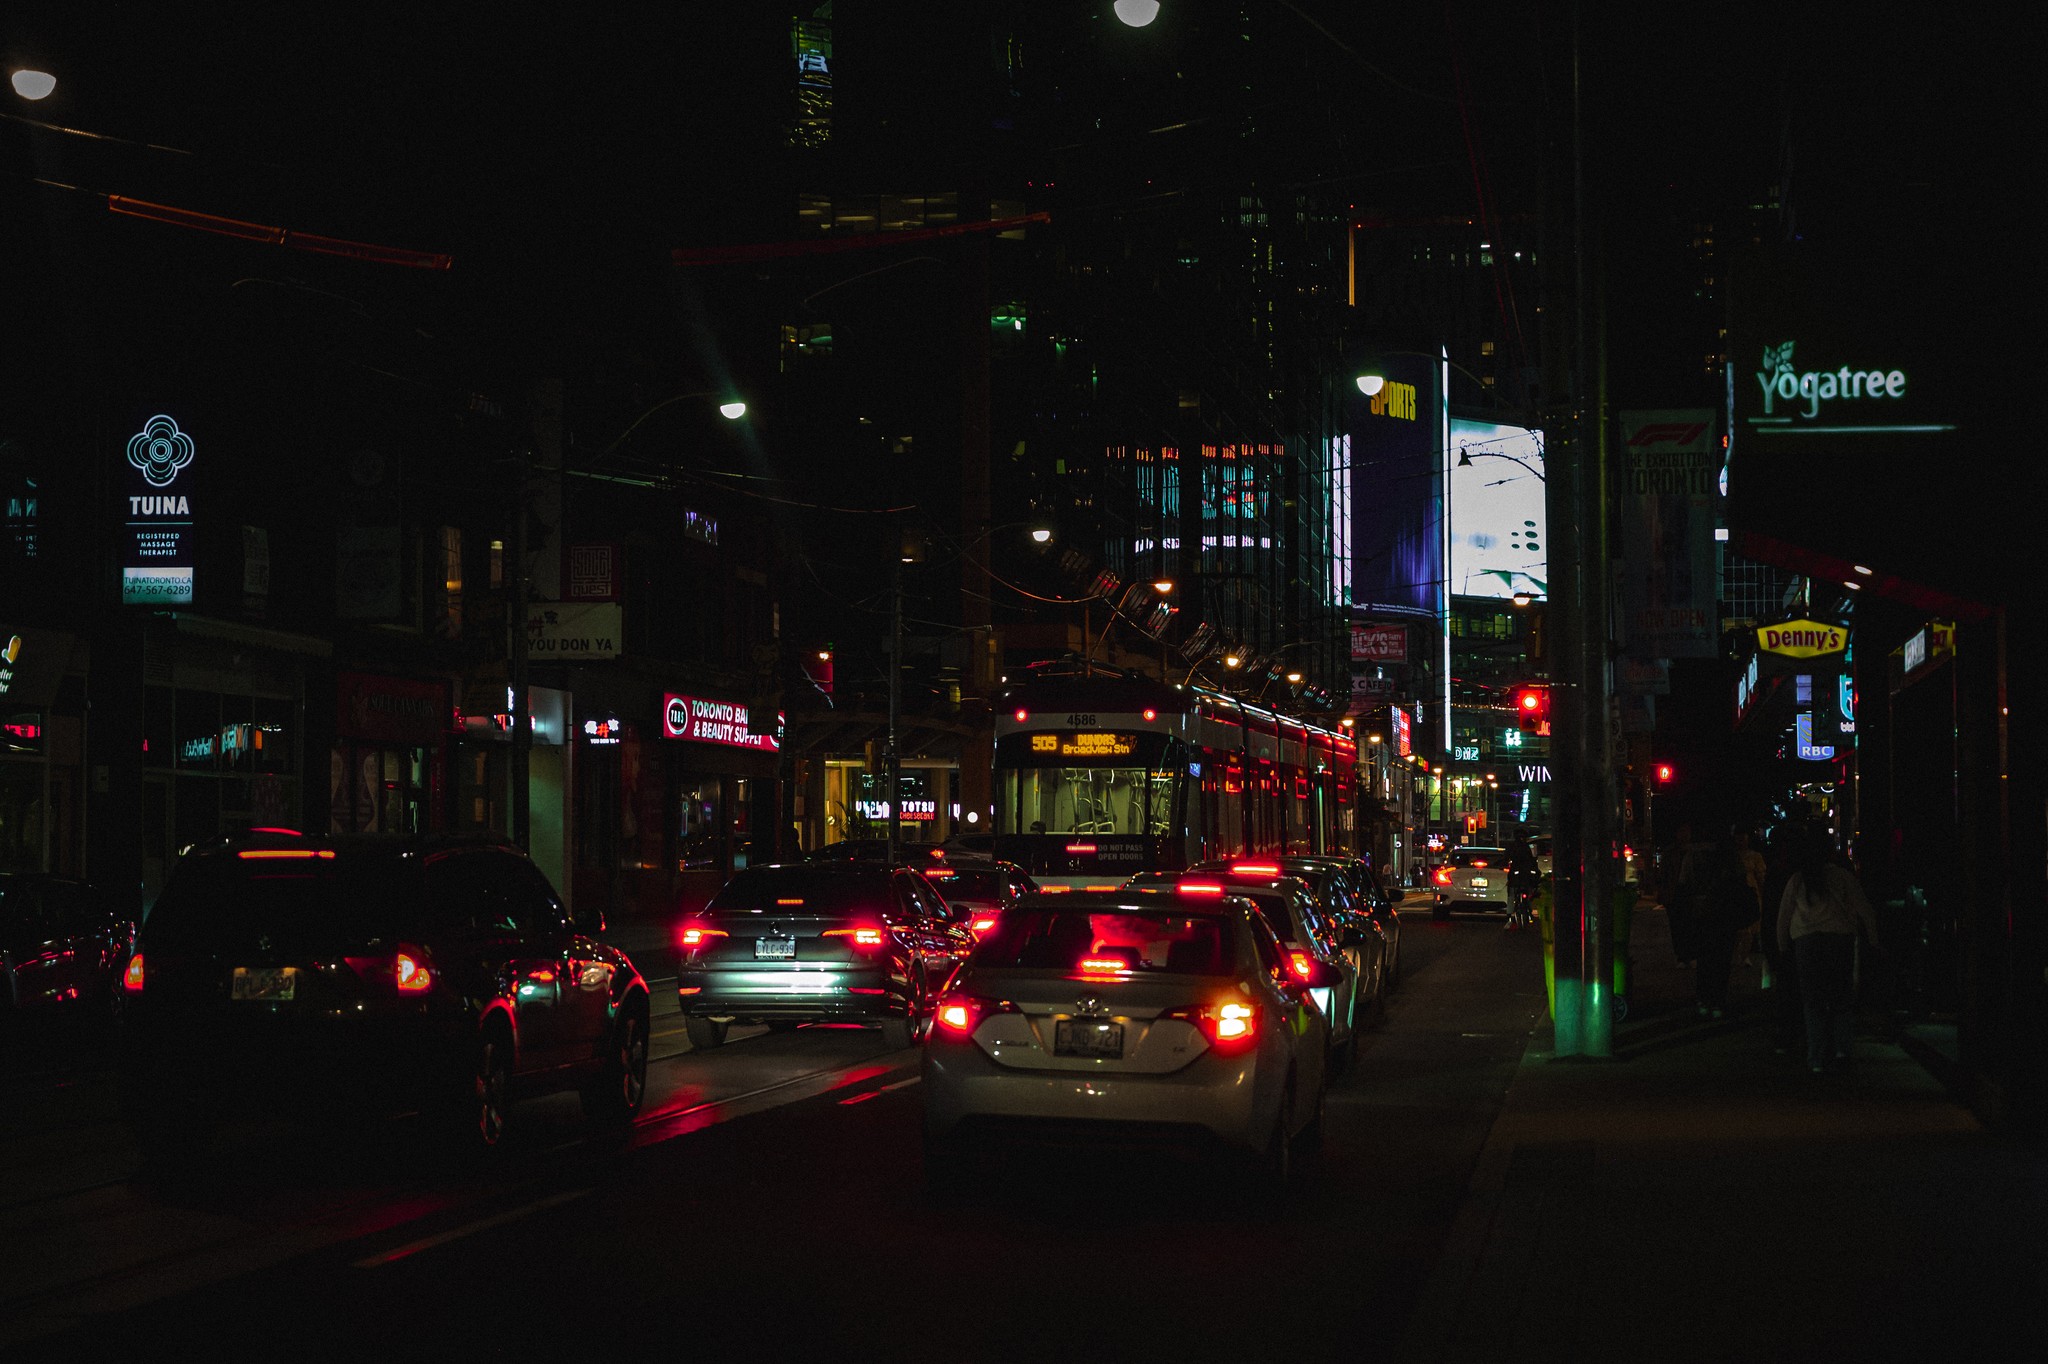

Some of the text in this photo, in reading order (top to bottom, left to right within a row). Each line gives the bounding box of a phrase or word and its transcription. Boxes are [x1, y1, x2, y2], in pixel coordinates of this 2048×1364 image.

[1757, 365, 1905, 418] Yogatree
[1646, 453, 1712, 467] EXHIBITION
[1625, 468, 1712, 495] TORONTO
[129, 496, 189, 515] TUINA
[124, 577, 192, 585] TUINATORONTO.CA
[124, 585, 191, 595] 647-567-6289
[1767, 626, 1840, 650] Denny's
[528, 639, 613, 651] YOU DON YA
[692, 700, 733, 722] TORONTO
[1067, 714, 1096, 725] 4586
[693, 720, 700, 737] &
[701, 721, 734, 742] BEAUTY
[1032, 736, 1057, 751] 505
[1077, 734, 1116, 746] DUNDAS
[1062, 744, 1130, 755] Broadview Stn
[1802, 746, 1831, 756] RBC
[1109, 844, 1123, 852] NOT
[1125, 844, 1144, 852] PASS
[1098, 853, 1144, 861] OPEN DOORS
